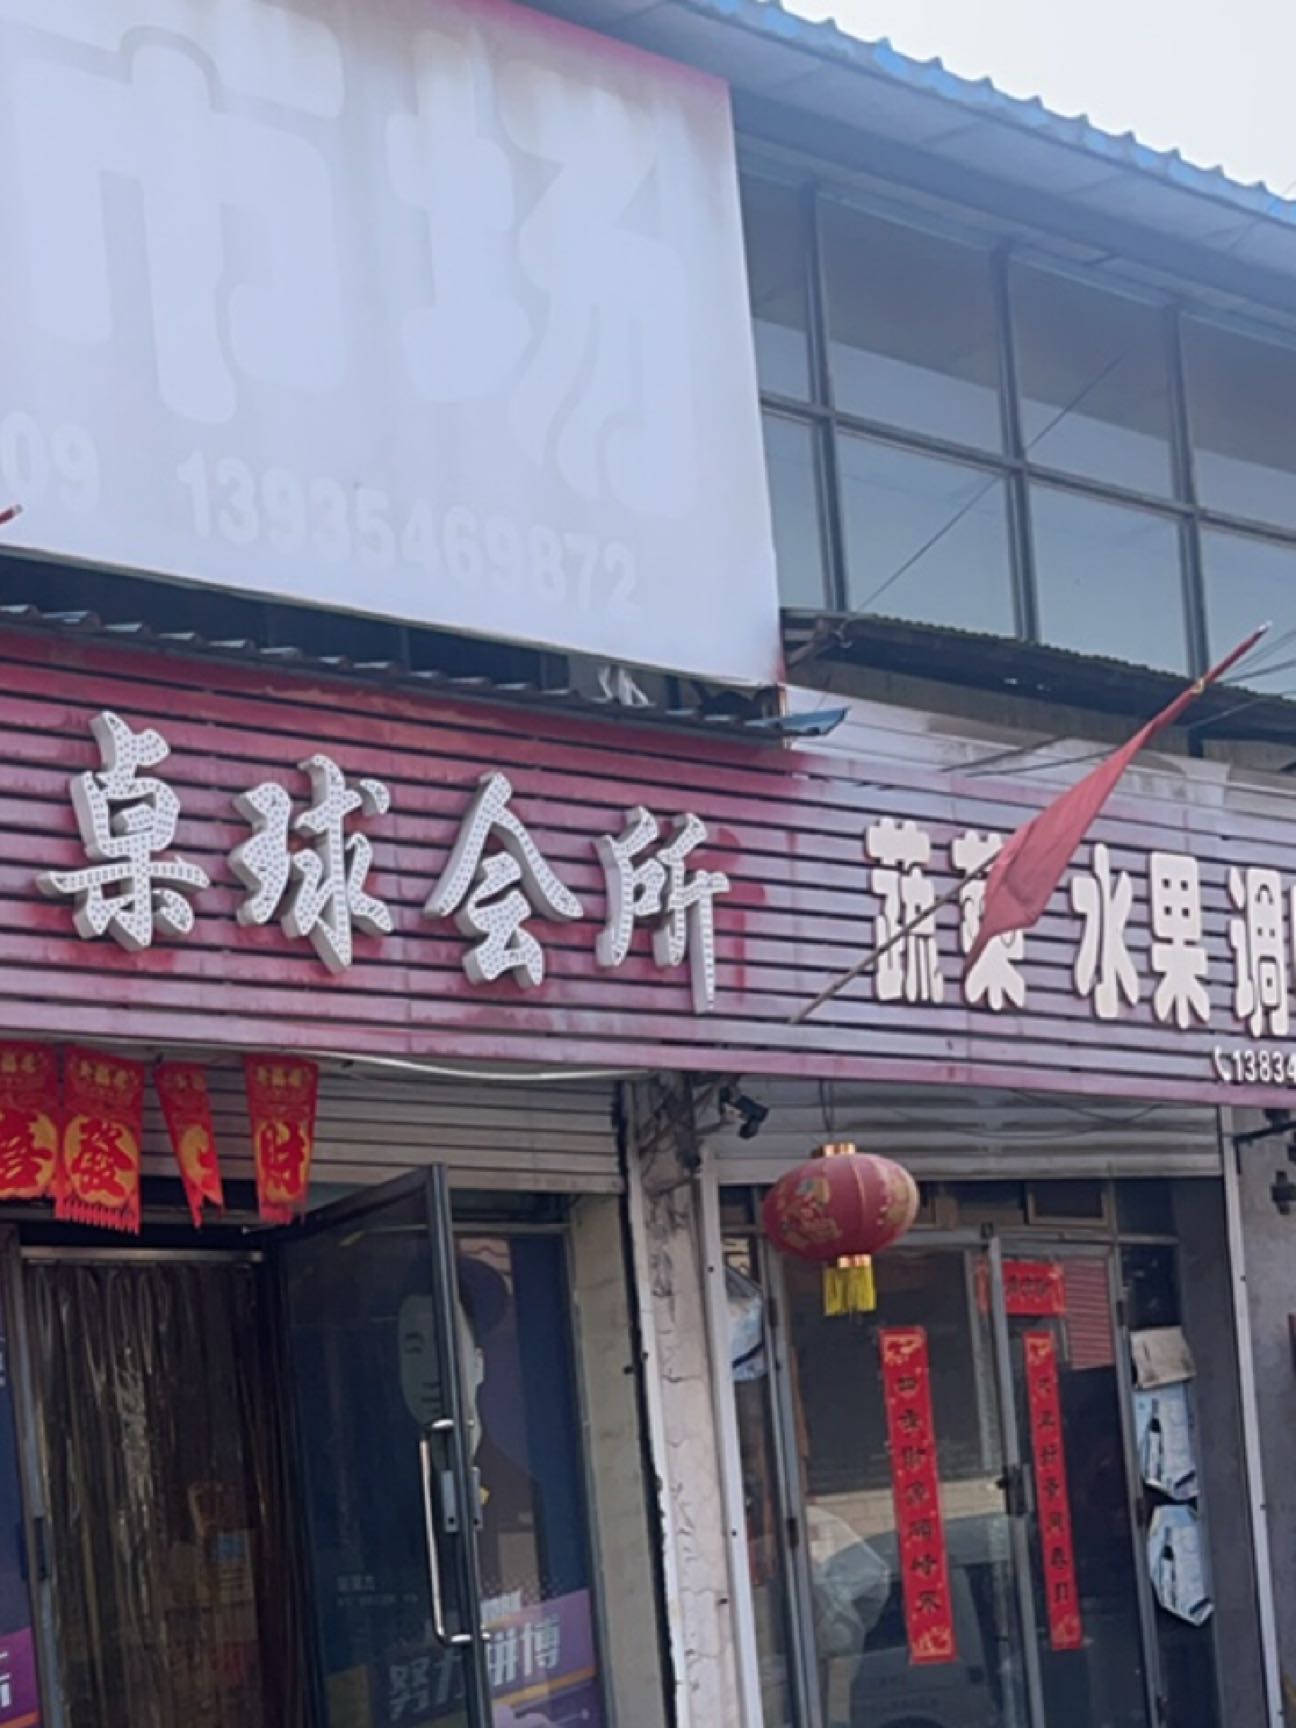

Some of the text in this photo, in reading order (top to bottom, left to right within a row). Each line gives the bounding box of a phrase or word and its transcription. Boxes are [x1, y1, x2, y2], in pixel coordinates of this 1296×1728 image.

[177, 451, 641, 622] 13935469872
[864, 817, 1296, 1037] 蔬菜水果调
